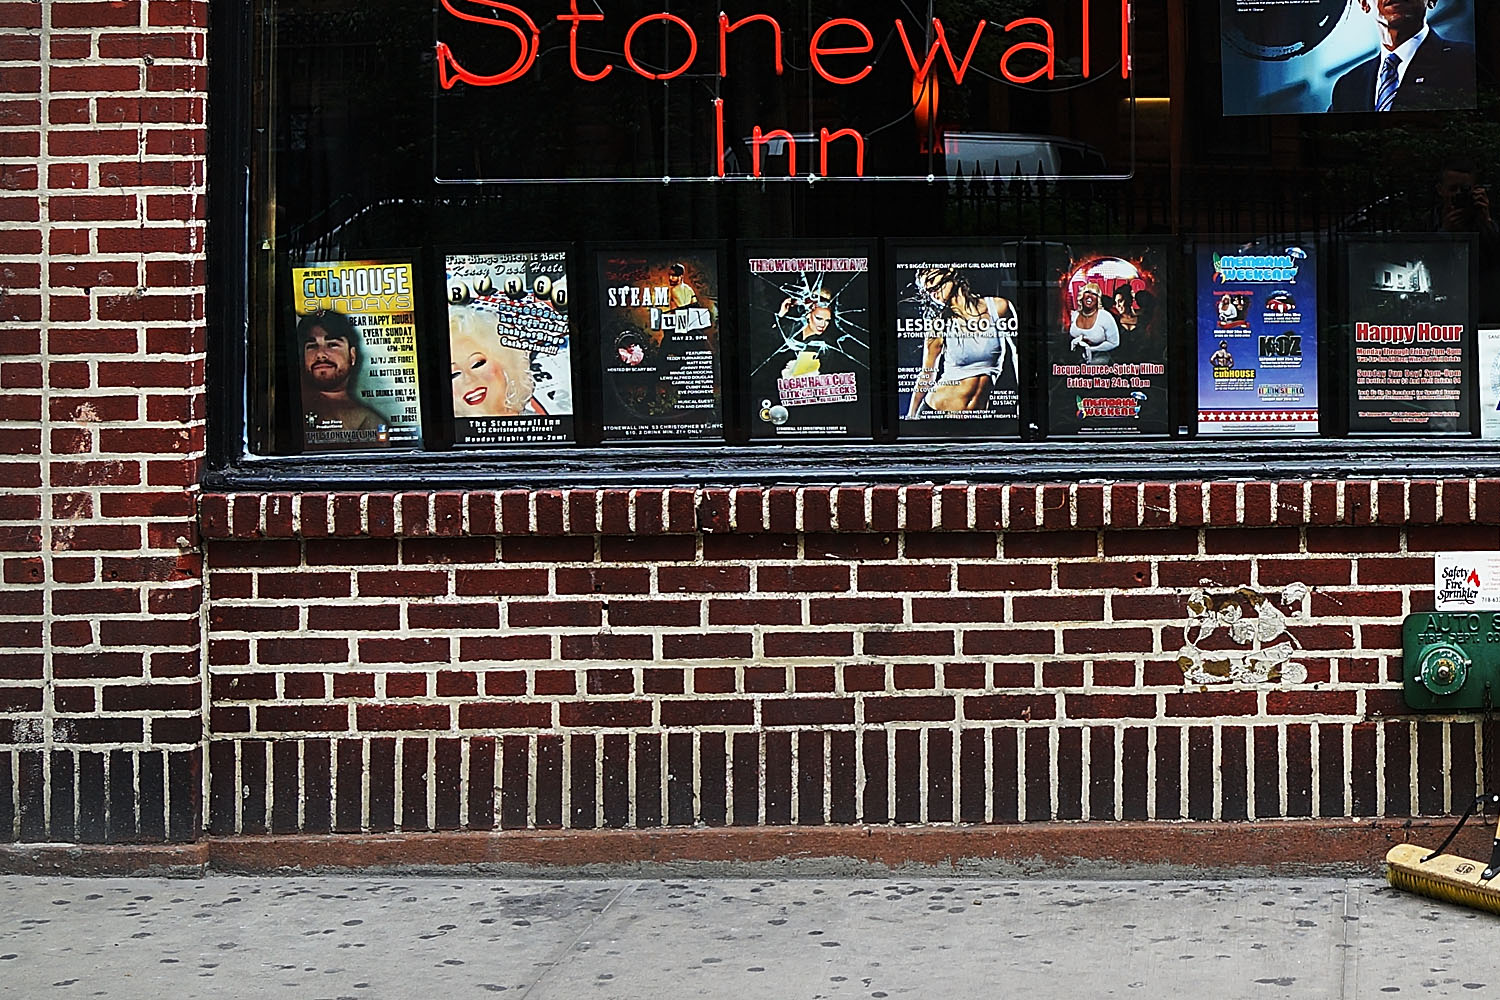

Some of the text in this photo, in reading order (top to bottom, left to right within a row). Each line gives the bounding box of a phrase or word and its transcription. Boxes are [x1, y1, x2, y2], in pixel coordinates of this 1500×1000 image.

[711, 98, 866, 178] Inn
[469, 256, 498, 265] Bingo
[501, 254, 528, 263] Bitch
[540, 252, 566, 260] Back
[1220, 256, 1294, 268] MEMORIAL
[749, 258, 814, 272] THROWDOWN
[1222, 268, 1297, 281] WEEKEND
[303, 266, 410, 298] cubHOUSE
[608, 286, 669, 307] STEAM
[304, 295, 411, 313] SUNDAYS
[368, 315, 390, 325] HAPPY
[392, 314, 412, 324] HOUR!
[896, 318, 1018, 332] LESBO-A-GO-GO
[363, 327, 412, 337] EVERY SUNDAY
[1356, 322, 1464, 344] Happy Hour
[1356, 348, 1382, 356] Monday
[1410, 348, 1431, 356] Friday
[1053, 364, 1080, 376] Jacque
[1081, 364, 1110, 376] Dupree
[1140, 363, 1164, 374] Hilton
[1214, 370, 1255, 378] cubHOUSE
[1357, 369, 1386, 378] Sunday
[1388, 369, 1402, 377] Fun
[777, 377, 808, 390] LOGAN
[1067, 378, 1092, 388] Friday
[1094, 378, 1110, 388] May
[1131, 377, 1150, 388] 10pm
[376, 389, 393, 397] DRINKS
[814, 386, 856, 396] THE DECKS
[1082, 398, 1138, 407] MEMORIAL
[1085, 407, 1136, 416] WEEKEND
[402, 414, 417, 422] DOGS!
[1442, 566, 1468, 581] Safety
[1446, 579, 1462, 589] Fire
[1437, 587, 1478, 602] Sprinkler
[1426, 613, 1480, 632] AUTO
[1418, 633, 1442, 644] FIRE
